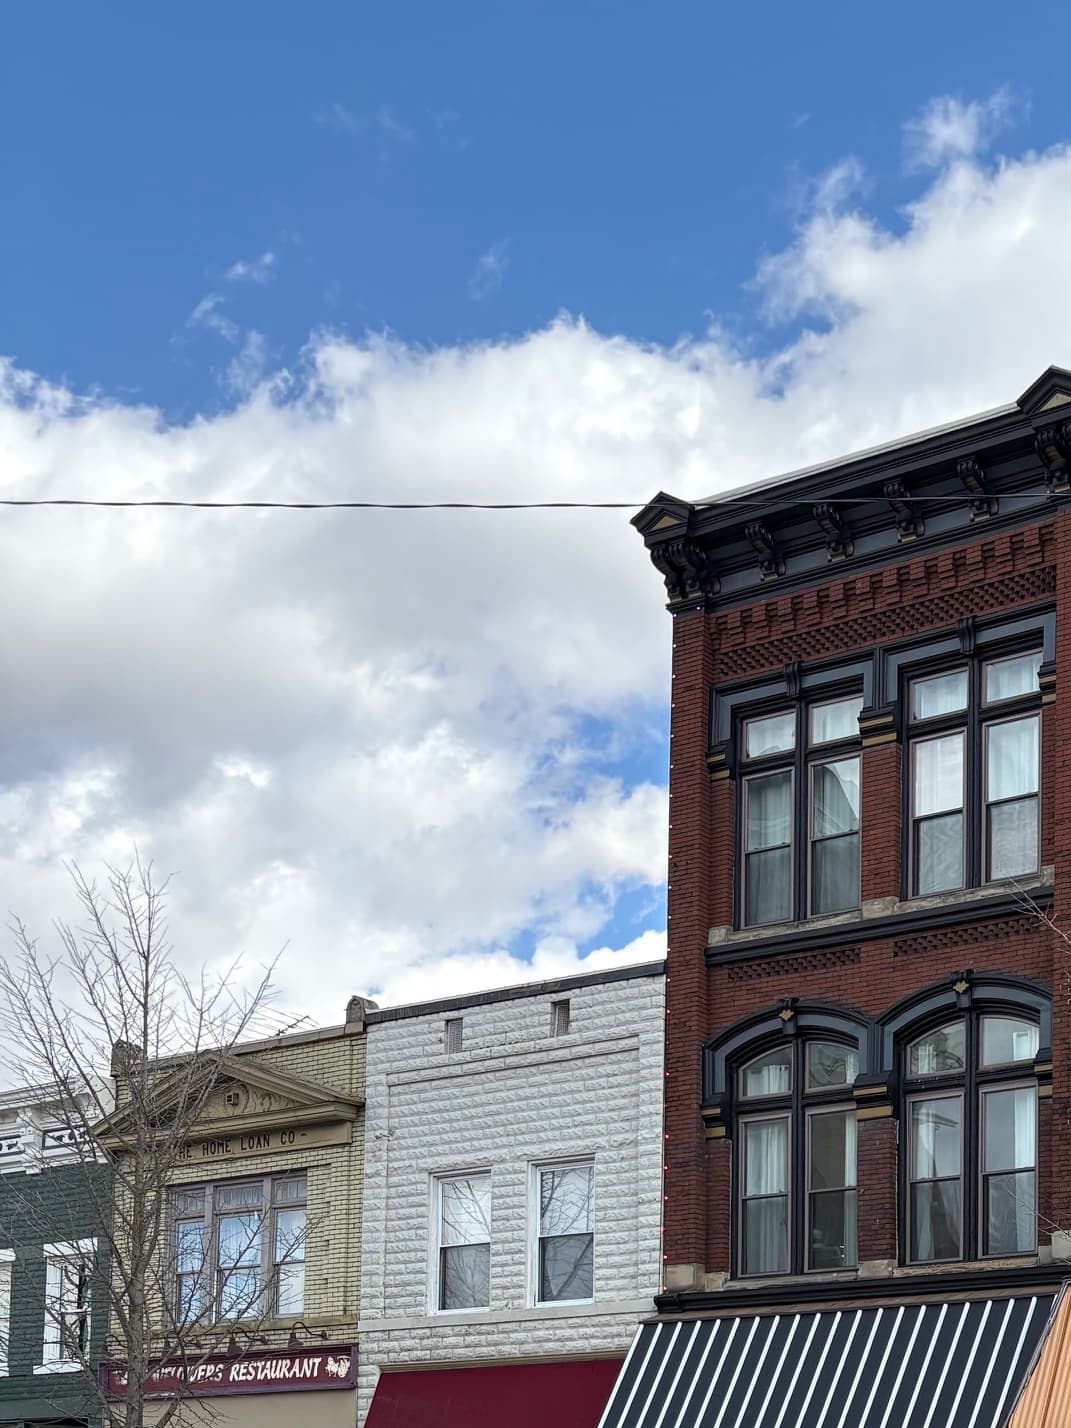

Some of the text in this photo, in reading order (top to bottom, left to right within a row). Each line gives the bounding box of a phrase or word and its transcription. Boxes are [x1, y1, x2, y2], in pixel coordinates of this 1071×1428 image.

[202, 1139, 232, 1156] HOME
[240, 1133, 270, 1151] LOAN
[229, 1356, 321, 1382] RESTAURANT
